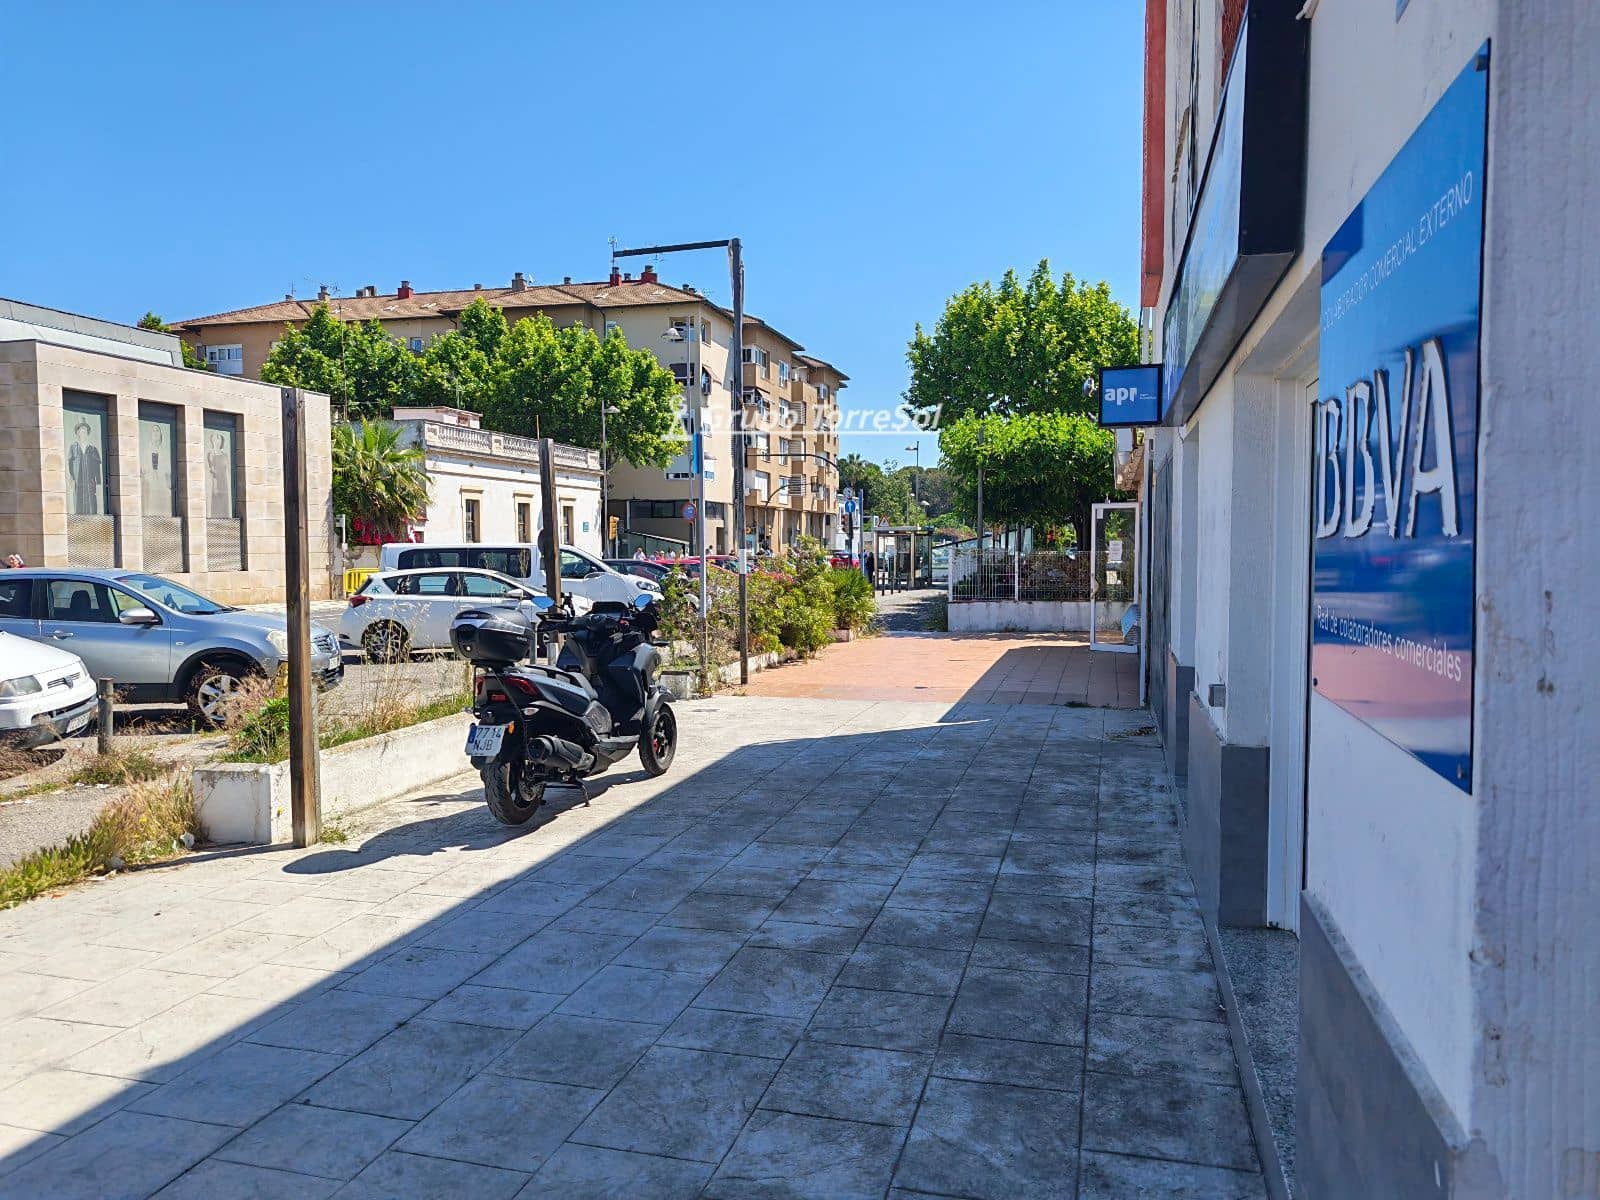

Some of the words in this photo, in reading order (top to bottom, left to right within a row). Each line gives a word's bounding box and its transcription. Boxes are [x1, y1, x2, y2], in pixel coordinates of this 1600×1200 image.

[1368, 228, 1416, 290] COMERCIAL
[1419, 171, 1473, 246] EXTERNO
[1104, 387, 1137, 406] apr
[1316, 337, 1459, 539] BBVA
[1317, 604, 1329, 630] Red
[1330, 610, 1338, 635] de
[1339, 613, 1392, 655] colaboradores
[1395, 636, 1462, 682] comerciales
